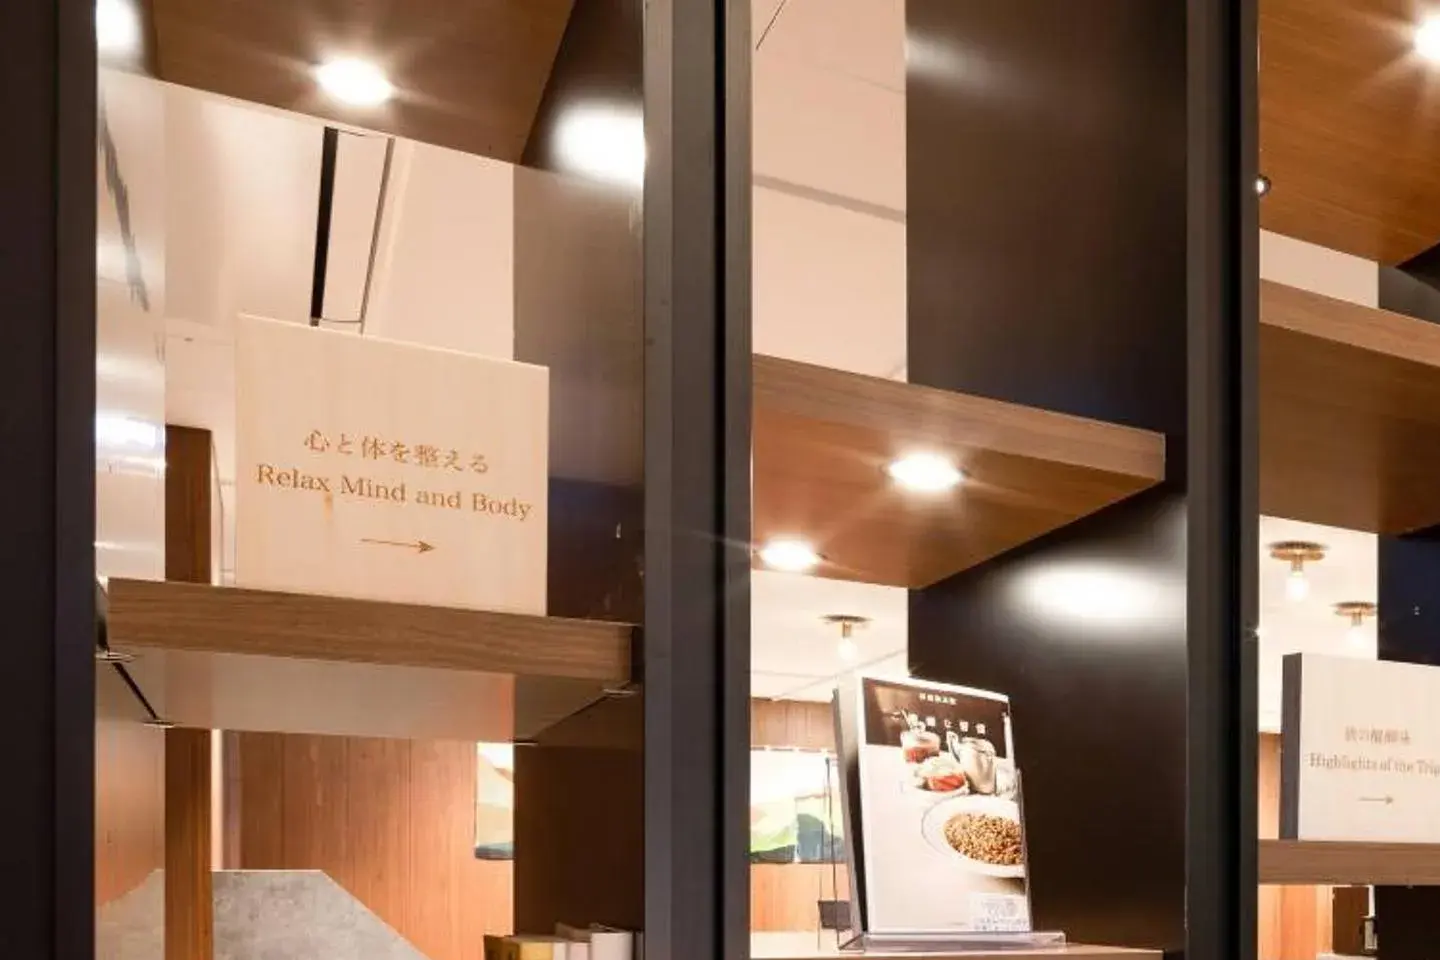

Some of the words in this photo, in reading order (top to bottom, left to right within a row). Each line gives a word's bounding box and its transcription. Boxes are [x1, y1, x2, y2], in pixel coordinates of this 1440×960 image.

[303, 428, 489, 475] 心と体を整える
[256, 463, 331, 492] Relax
[340, 474, 406, 503] Mind
[415, 488, 462, 510] and
[471, 491, 533, 521] Body
[1309, 751, 1378, 771] Highlights
